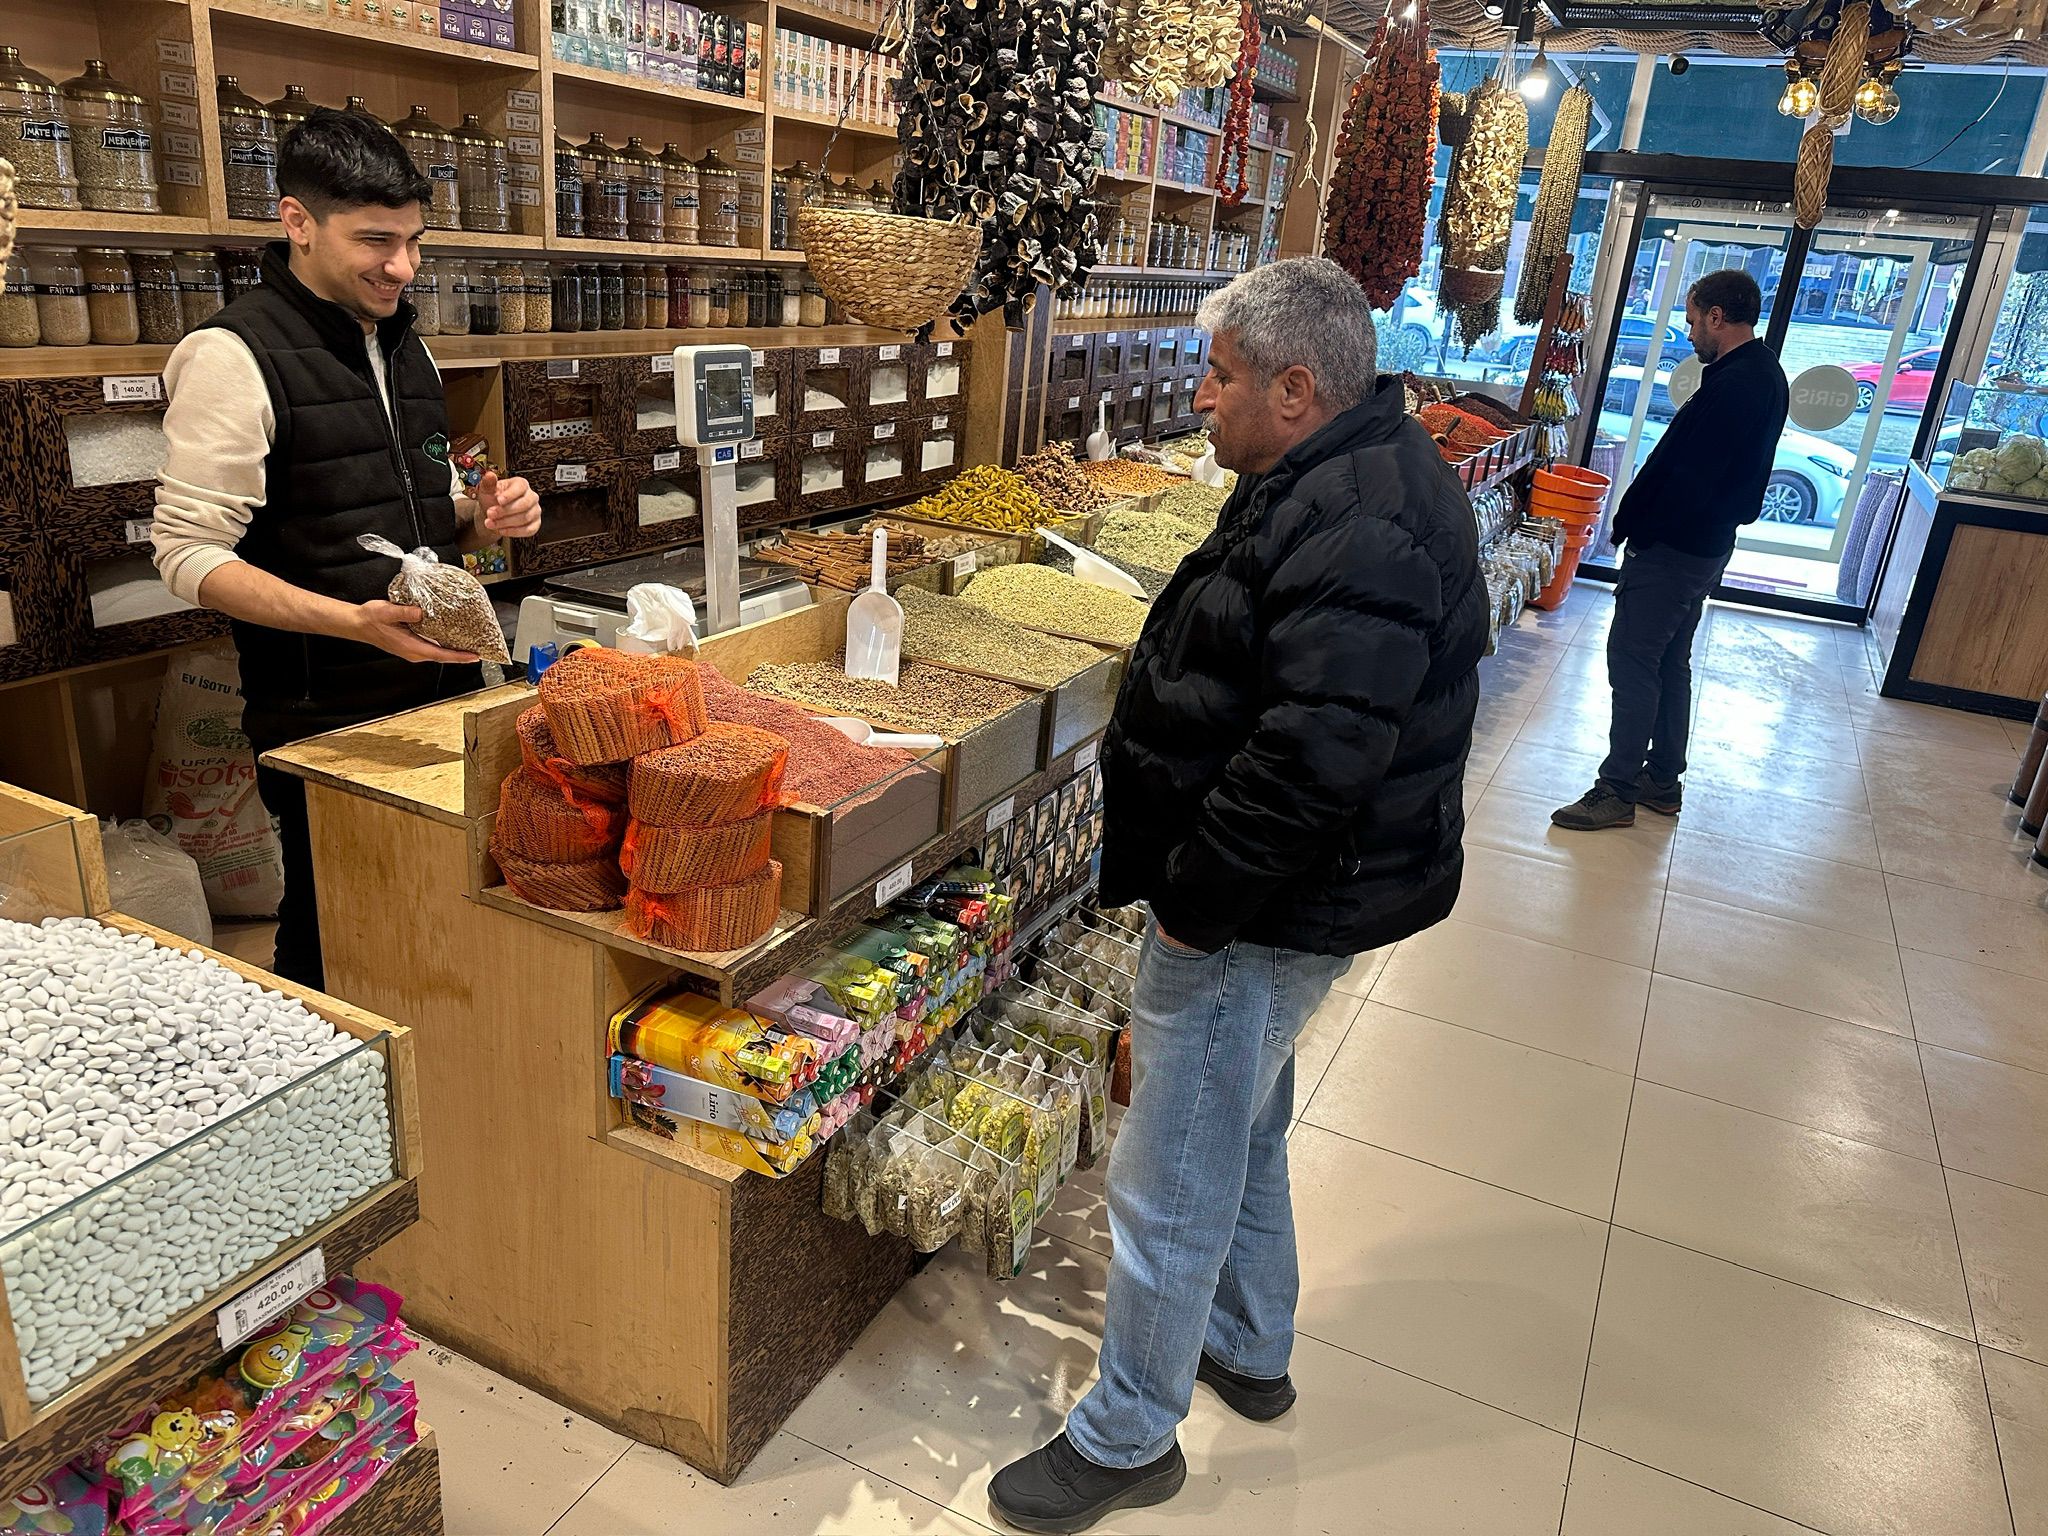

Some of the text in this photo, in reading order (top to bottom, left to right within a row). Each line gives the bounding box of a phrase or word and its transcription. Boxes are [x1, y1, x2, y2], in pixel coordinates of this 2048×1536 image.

[444, 23, 460, 33] Kids
[470, 28, 486, 38] Kids
[495, 33, 511, 43] Kids
[717, 450, 732, 459] CAS
[182, 672, 196, 685] EV
[199, 675, 232, 694] İSOTU
[182, 757, 228, 767] URFA
[709, 1017, 728, 1030] Sun
[709, 1091, 719, 1120] Lirio
[234, 1292, 254, 1308] BEYAZ
[257, 1280, 294, 1310] 420.00
